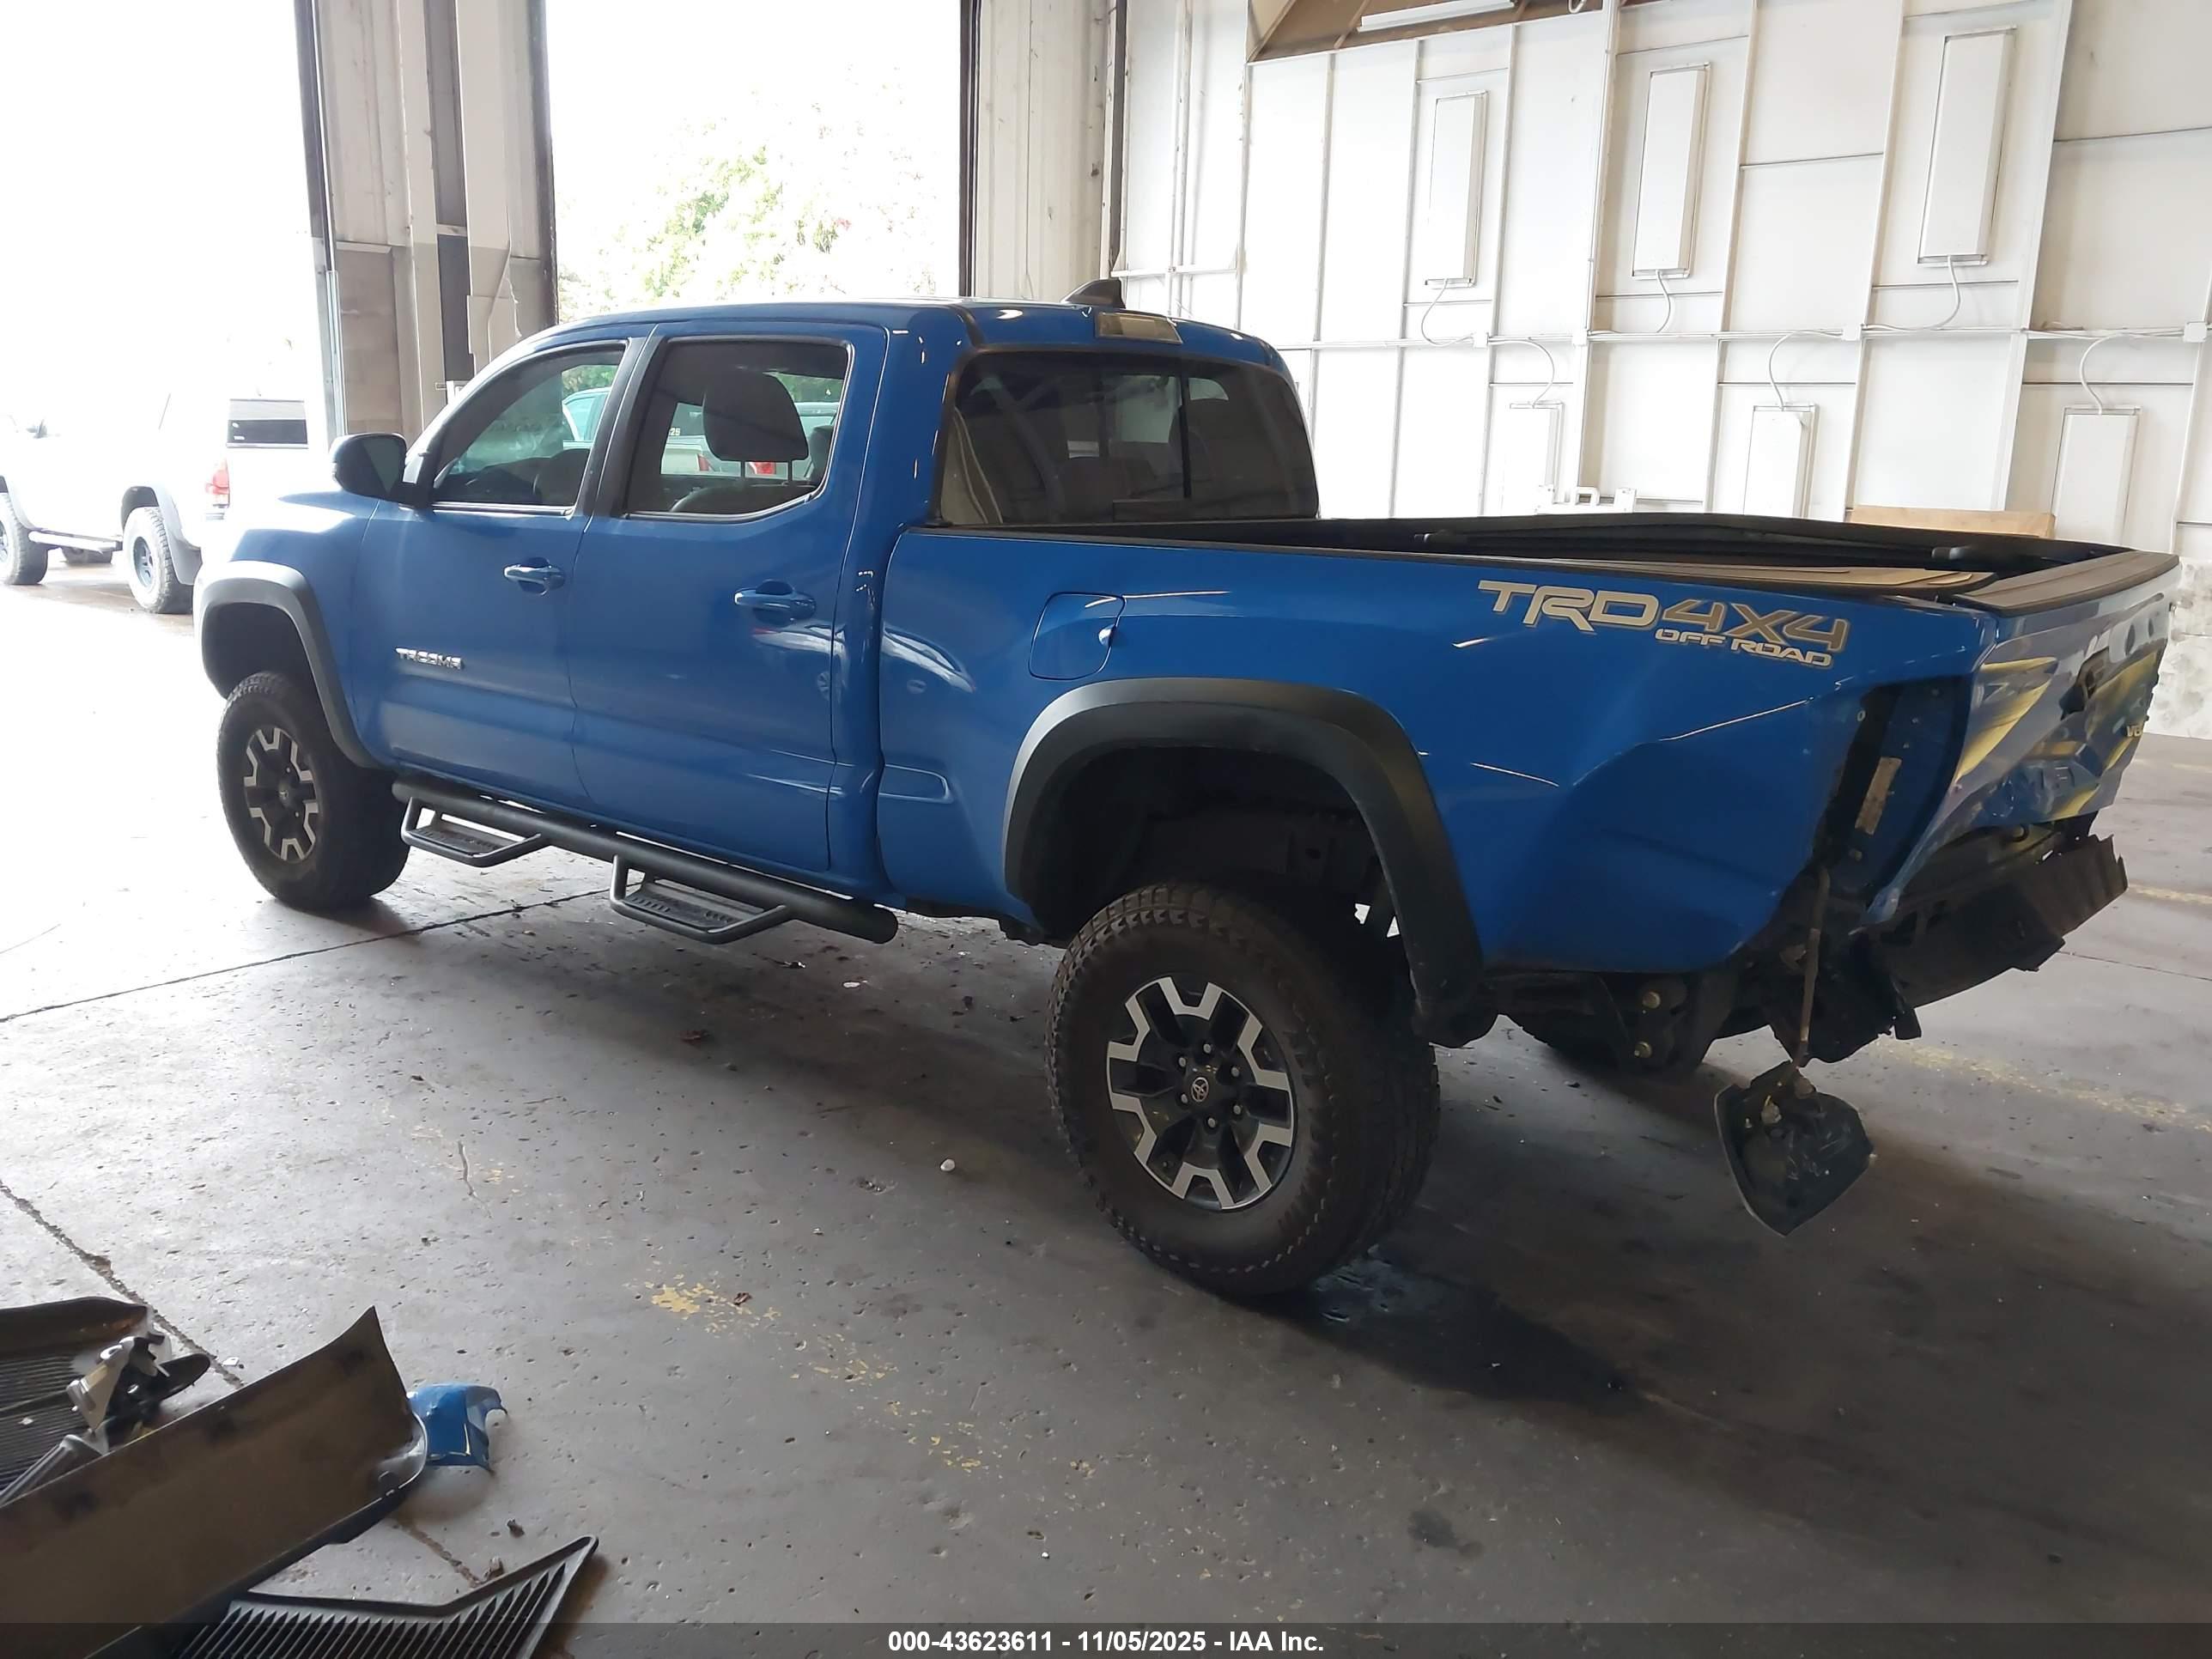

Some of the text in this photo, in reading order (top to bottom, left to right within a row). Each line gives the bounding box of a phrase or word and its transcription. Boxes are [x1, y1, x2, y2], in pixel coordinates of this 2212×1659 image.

[1478, 580, 1850, 653] TRD 4X4
[1655, 628, 1832, 668] OFF ROAD
